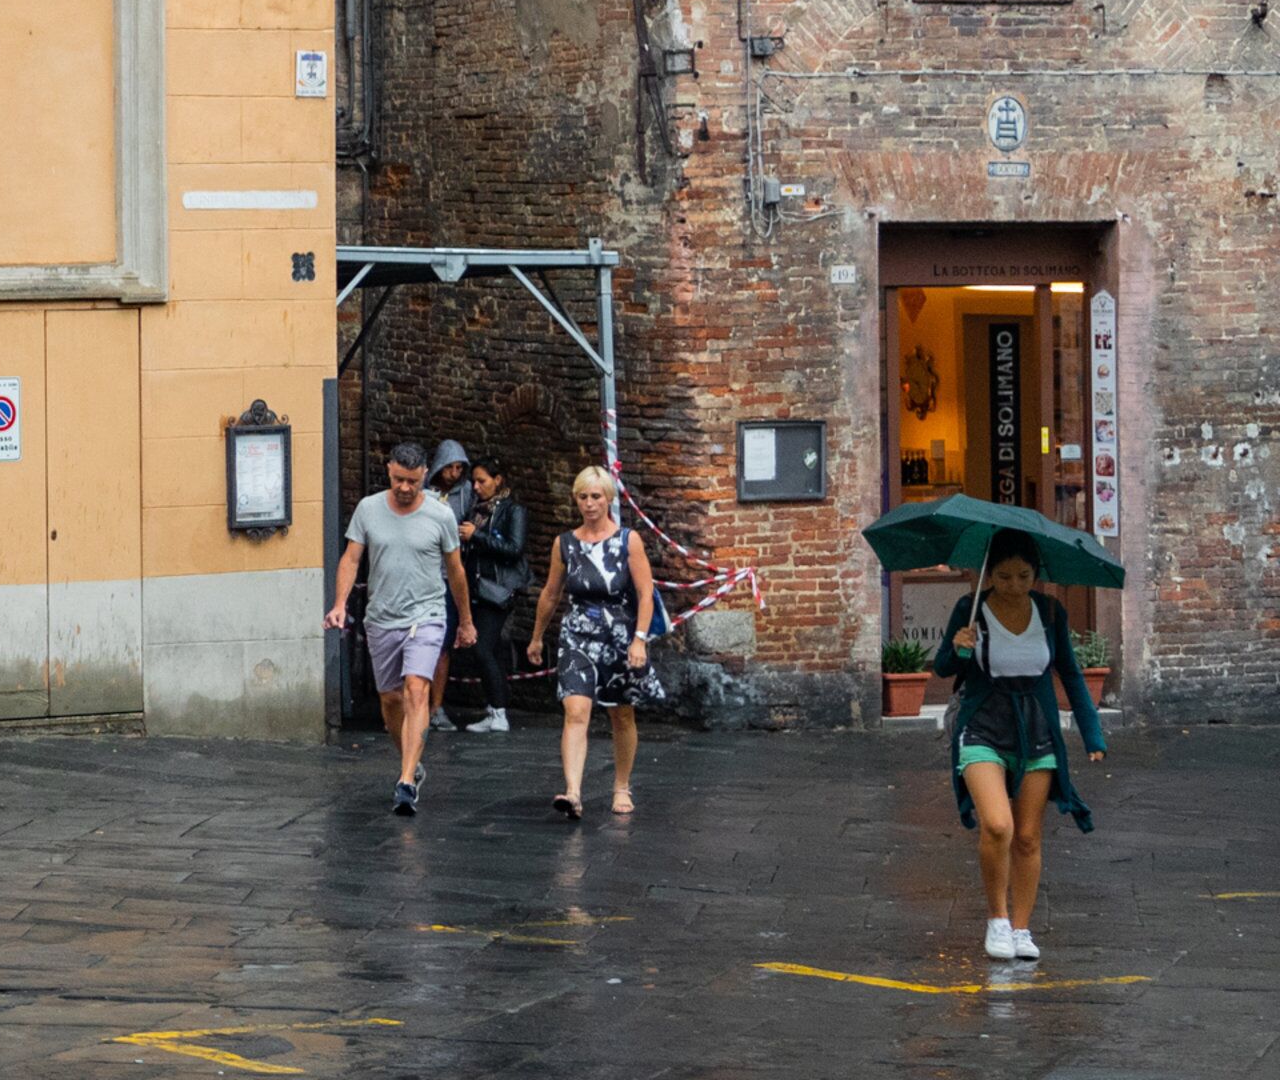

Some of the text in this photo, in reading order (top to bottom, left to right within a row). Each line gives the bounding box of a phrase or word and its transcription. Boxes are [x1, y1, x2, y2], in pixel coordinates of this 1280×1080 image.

[933, 264, 948, 277] LA
[1009, 265, 1020, 276] DI
[1023, 264, 1081, 276] SOLIMANO
[996, 330, 1015, 437] SOLIMANO
[998, 442, 1015, 461] DI
[902, 627, 946, 640] NOMIA
